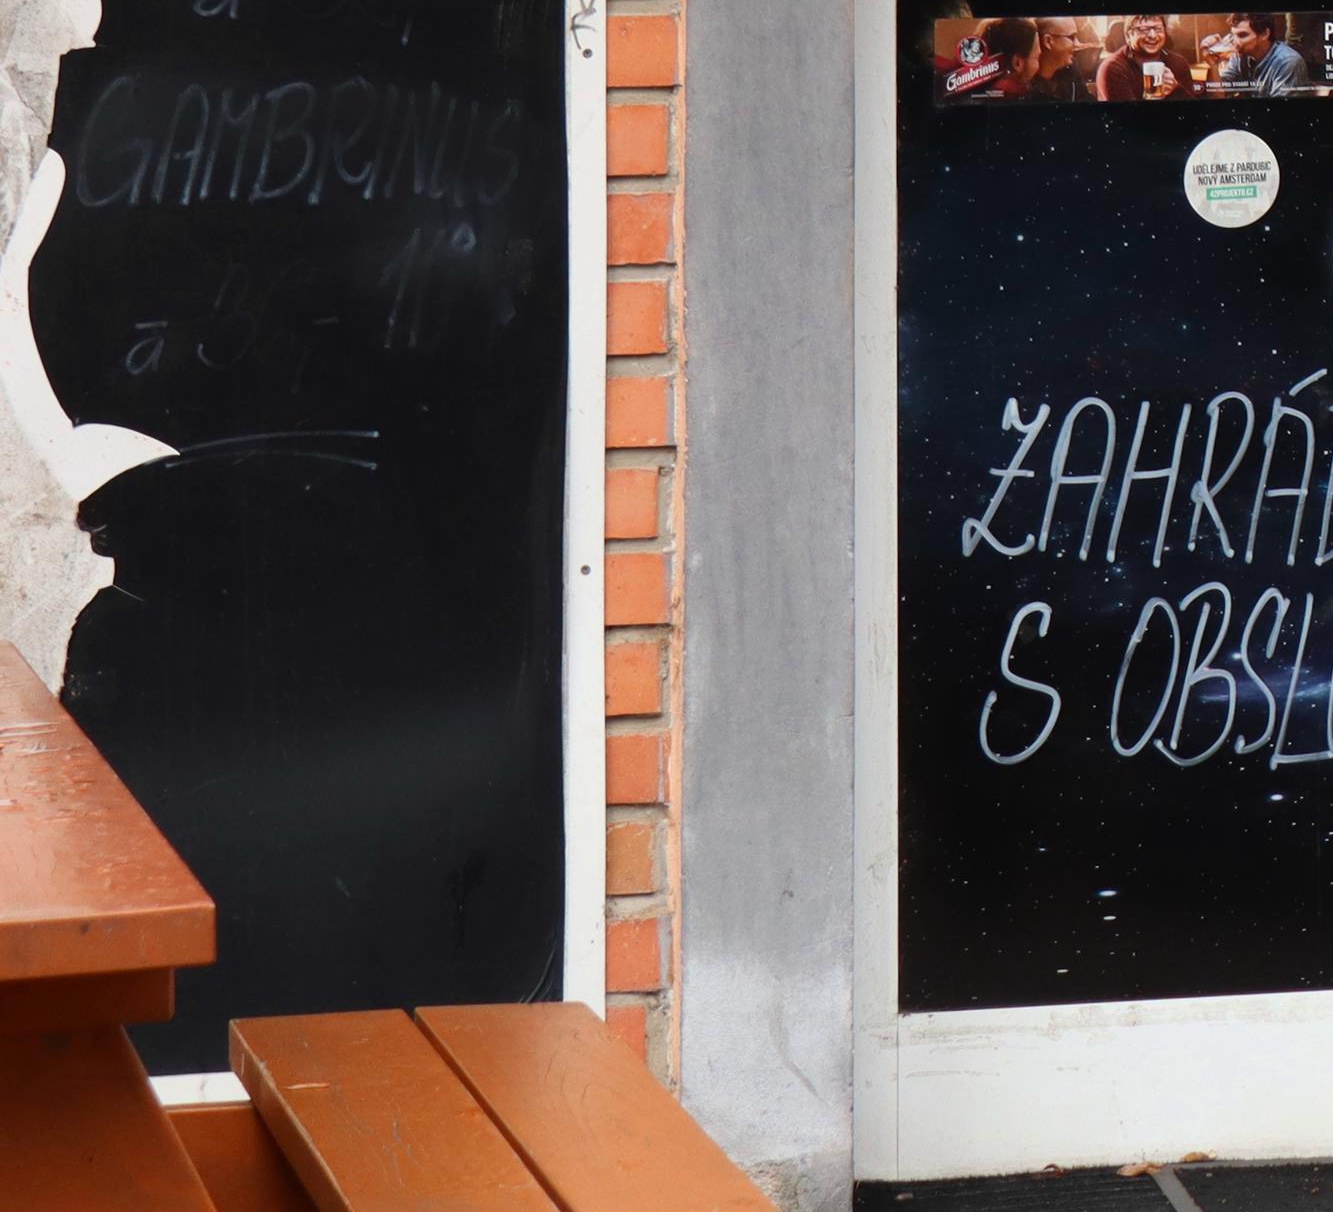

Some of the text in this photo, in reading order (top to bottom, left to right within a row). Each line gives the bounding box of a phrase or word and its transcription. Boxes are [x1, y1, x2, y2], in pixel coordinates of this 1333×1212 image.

[946, 61, 1000, 91] Gambrinus
[1230, 163, 1235, 173] Z
[1236, 161, 1271, 173] PARDUBIC
[1219, 173, 1266, 185] AMSTERDAM
[979, 601, 1061, 766] S
